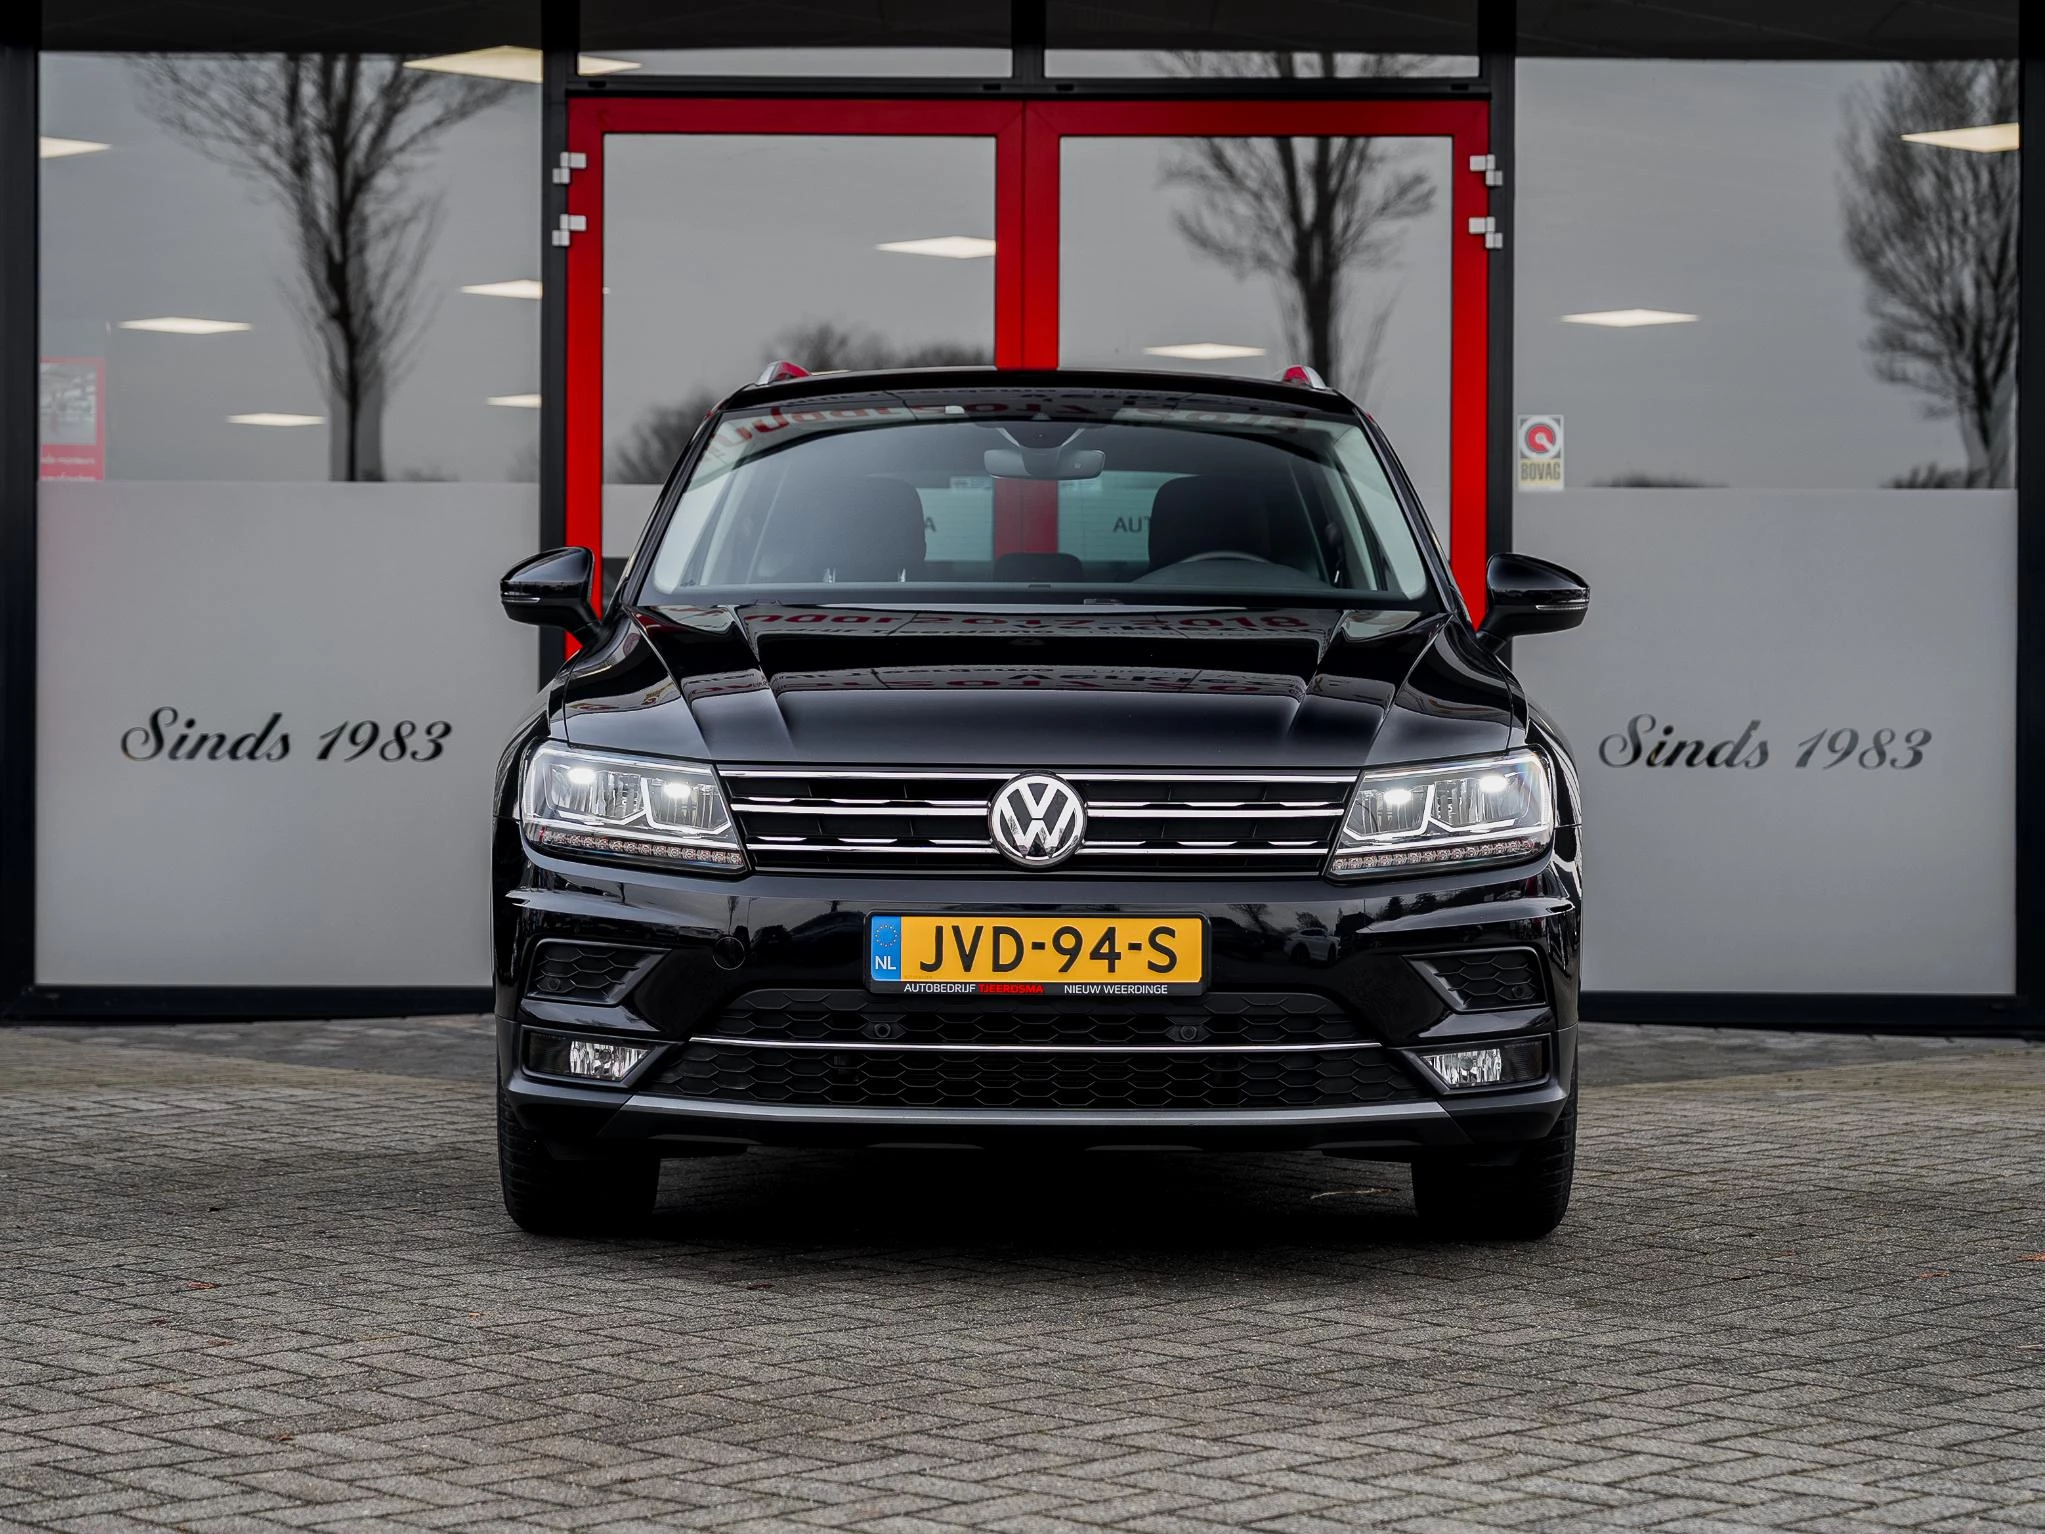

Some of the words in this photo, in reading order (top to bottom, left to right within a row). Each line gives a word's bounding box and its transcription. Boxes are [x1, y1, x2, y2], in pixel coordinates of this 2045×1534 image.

[1520, 461, 1561, 481] BOVAG
[120, 705, 290, 762] Sinds
[316, 720, 453, 763] 1983
[1598, 713, 1770, 769] Sinds
[1795, 727, 1933, 770] 1983
[875, 955, 897, 970] NL
[919, 924, 1178, 974] JVD-94-S
[903, 983, 976, 993] AUTOBEDRIJF
[978, 984, 1044, 994] TJEERDSMA
[1064, 984, 1101, 994] NIEUW
[1103, 984, 1168, 994] WEERDINGE
